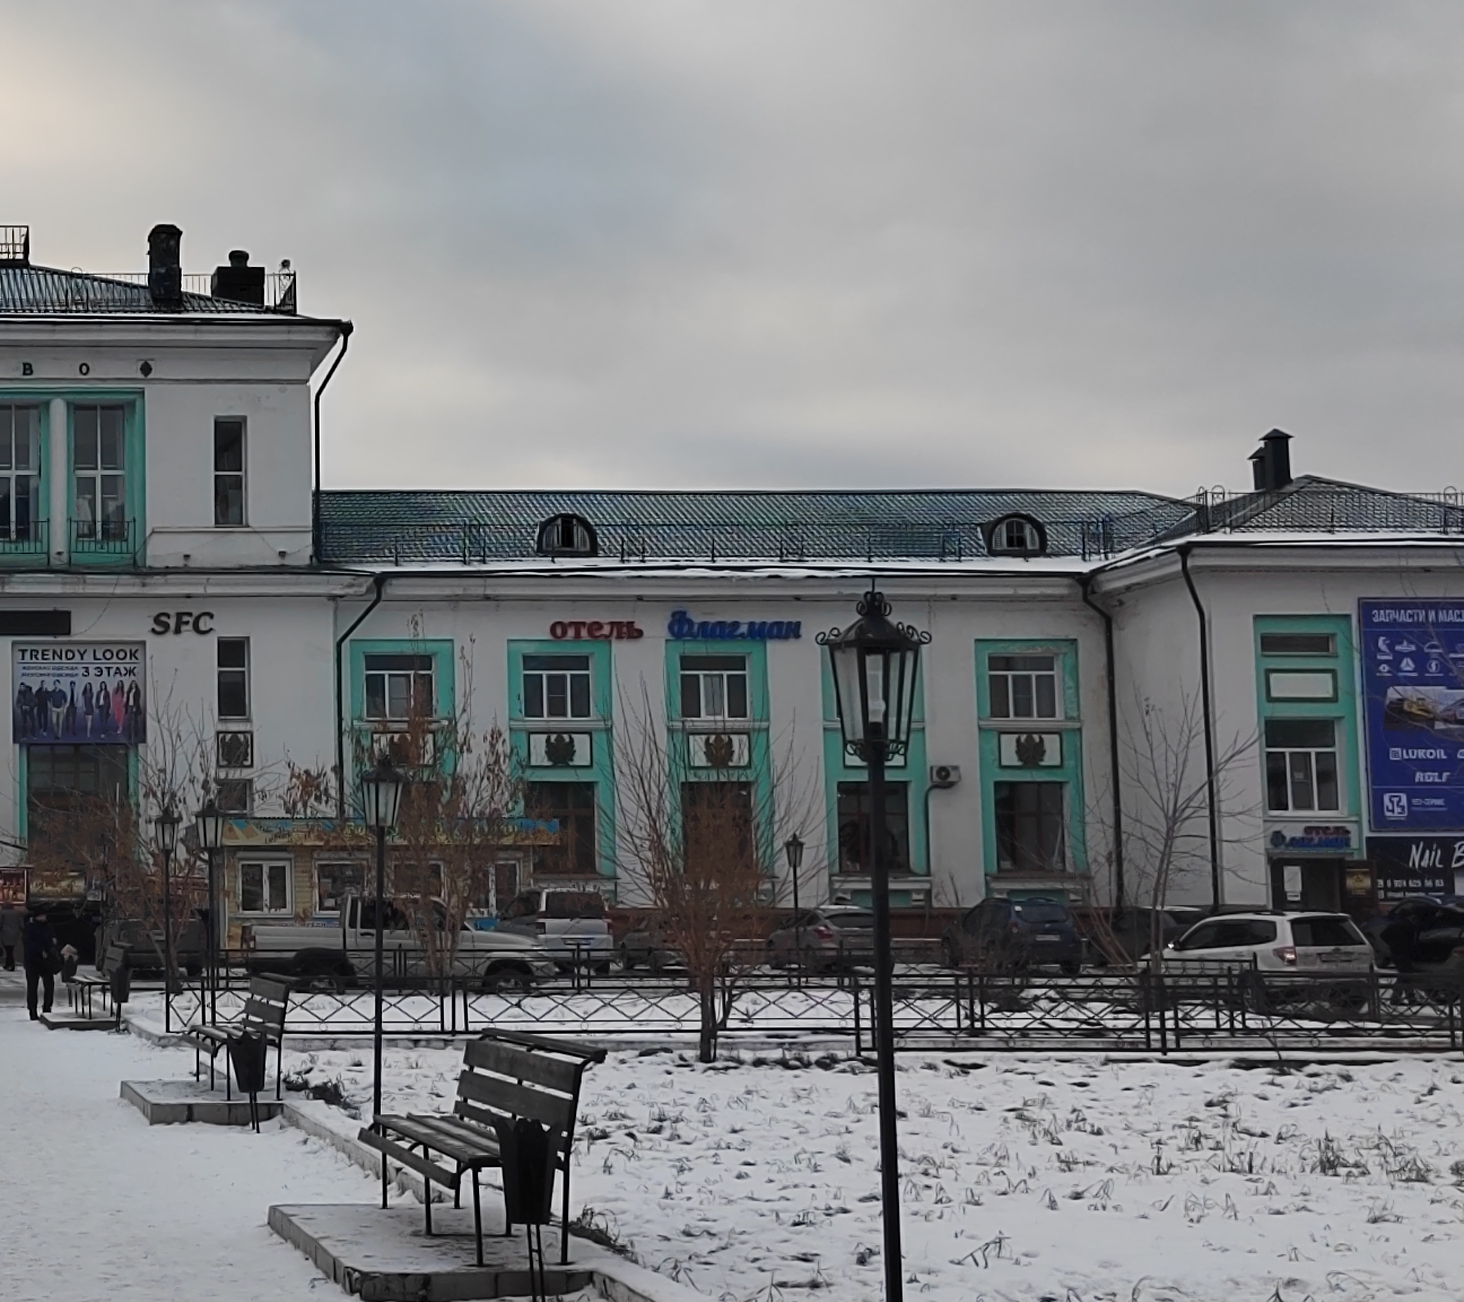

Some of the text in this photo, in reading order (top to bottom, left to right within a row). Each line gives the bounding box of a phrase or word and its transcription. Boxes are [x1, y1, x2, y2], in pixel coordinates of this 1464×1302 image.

[1372, 609, 1426, 623] ЗАПЧАСТИ
[1428, 609, 1437, 623] И
[151, 612, 215, 635] SFC
[667, 610, 802, 641] Флагман
[18, 649, 140, 661] TRENDY LOOK
[81, 666, 138, 678] 3 ЭТАЖ
[1402, 748, 1447, 760] LUKOIL
